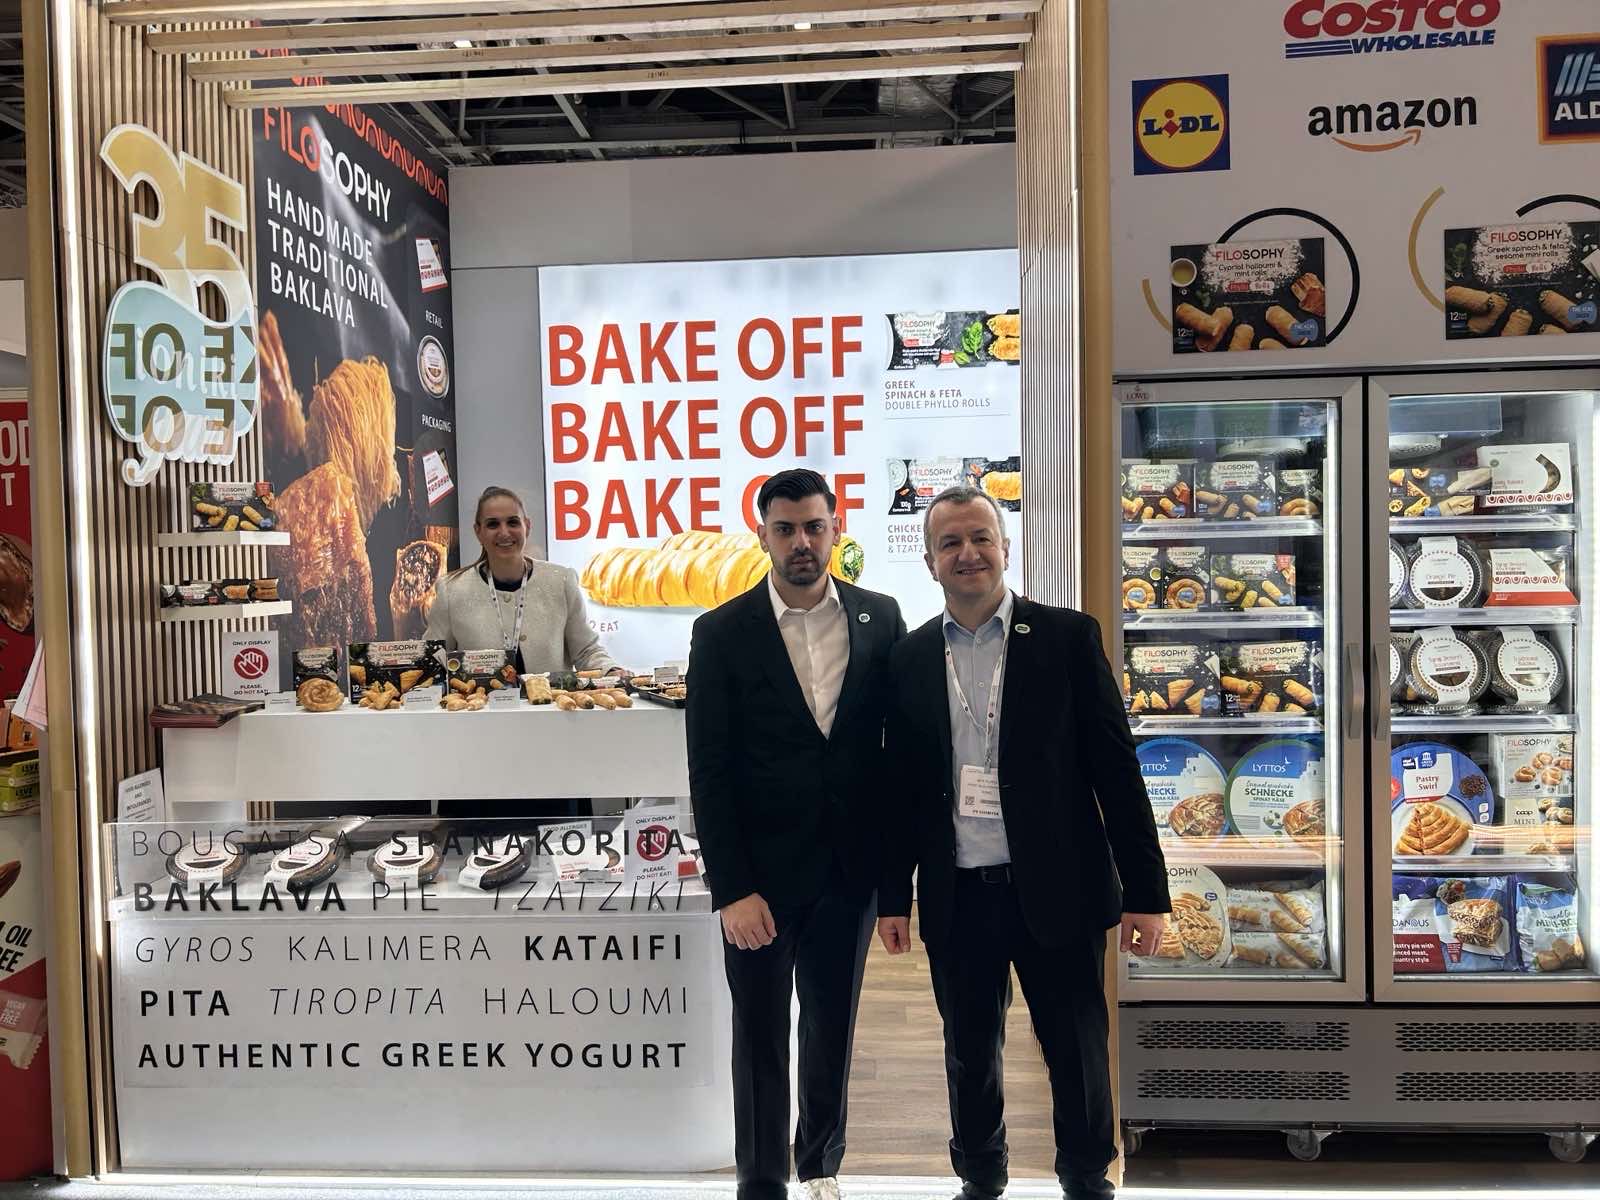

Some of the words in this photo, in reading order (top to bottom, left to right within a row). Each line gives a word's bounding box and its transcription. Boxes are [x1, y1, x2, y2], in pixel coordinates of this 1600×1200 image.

[1284, 0, 1501, 39] COSTCO
[1352, 30, 1496, 55] WHOLESALE
[1308, 96, 1477, 137] amazon
[264, 107, 391, 223] FILOSOPHY
[267, 177, 374, 266] HANDMADE
[1490, 229, 1562, 243] FILOSOPHY
[1215, 248, 1285, 262] FILOSOPHY
[1487, 246, 1512, 254] Greek
[1513, 244, 1541, 254] spinach
[267, 219, 388, 309] TRADITIONAL
[1218, 264, 1244, 273] Cypriot
[270, 262, 356, 328] BAKLAVA
[425, 309, 443, 329] RETAIL
[1450, 312, 1458, 321] 12
[1177, 328, 1187, 336] 12
[549, 320, 719, 386] BAKE
[738, 316, 863, 381] OFF
[885, 380, 915, 389] GREEK
[885, 390, 926, 399] SPINACH
[929, 390, 936, 398] &
[939, 389, 962, 398] FETA
[885, 401, 921, 410] DOUBLE
[924, 399, 959, 408] PHYLLO
[962, 398, 990, 407] ROLLS
[421, 414, 452, 433] PACKAGING
[551, 399, 721, 464] BAKE
[740, 395, 864, 459] OFF
[554, 477, 723, 541] BAKE
[741, 473, 865, 535] OF
[888, 525, 923, 534] CHICKE
[888, 545, 894, 553] &
[897, 544, 924, 553] TZATZ
[600, 620, 619, 632] EAT
[378, 644, 418, 652] FILOSOPHY
[1143, 649, 1188, 657] FILOSOPHY
[1251, 646, 1298, 655] FILOSOPHY
[1225, 694, 1234, 702] 12
[1507, 738, 1552, 747] FILOSOPHY
[1252, 763, 1286, 773] LYTTOS
[1416, 774, 1439, 783] Pastry
[1244, 787, 1294, 797] SCHNECKE
[1418, 782, 1438, 791] Swirl
[132, 830, 355, 857] BOUGATSA
[134, 882, 347, 912] BAKLAVA
[372, 881, 439, 911] PIE
[493, 881, 684, 911] TZATZIKI
[5, 925, 32, 948] OIL
[135, 936, 254, 963] GYROS
[288, 935, 491, 961] KALIMERA
[525, 934, 682, 961] KATAIFI
[140, 990, 230, 1017] PITA
[269, 987, 443, 1015] TIROPITA
[484, 987, 687, 1015] HALOUMI
[138, 1043, 360, 1068] AUTHENTIC
[382, 1042, 506, 1068] GREEK
[525, 1042, 687, 1068] YOGURT
